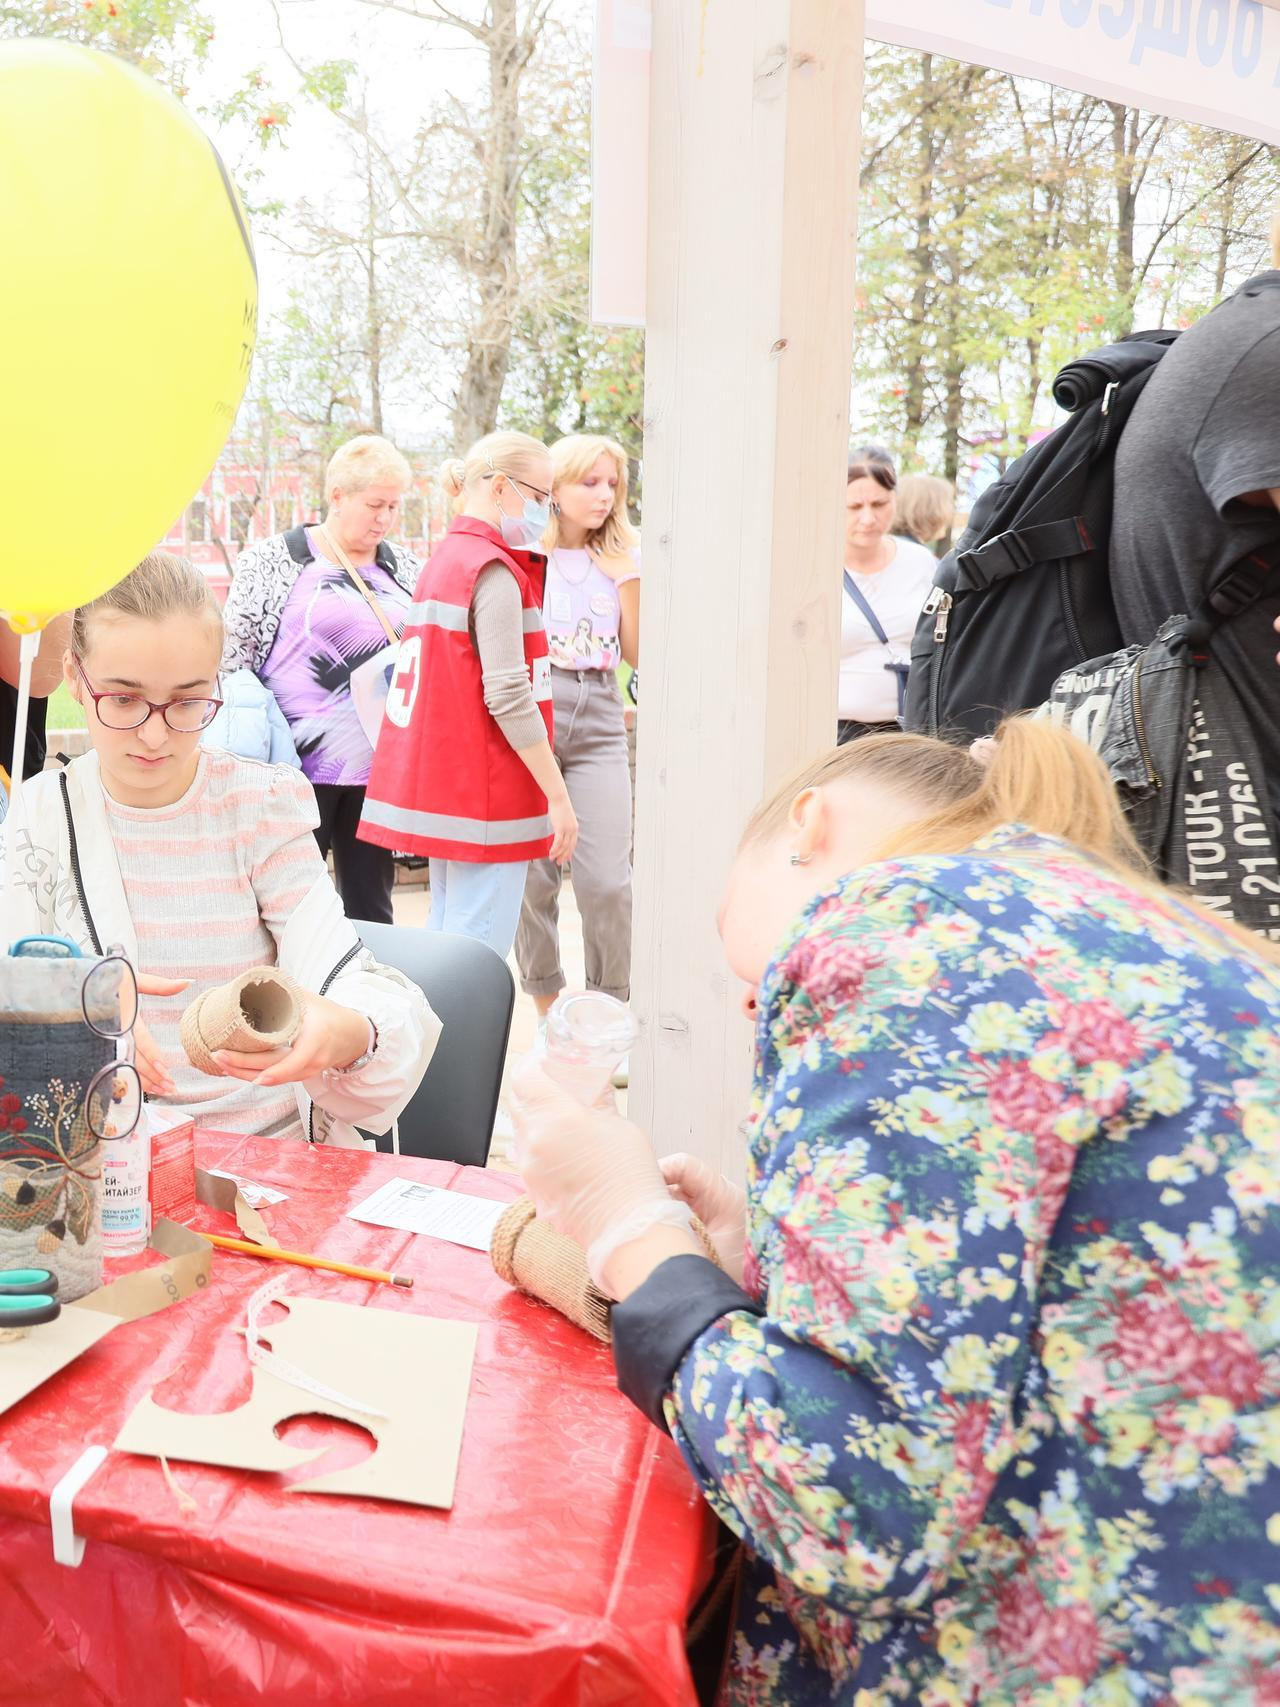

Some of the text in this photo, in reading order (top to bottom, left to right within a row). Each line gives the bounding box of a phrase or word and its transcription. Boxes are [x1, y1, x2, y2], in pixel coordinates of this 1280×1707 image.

[1183, 789, 1229, 886] TOUR
[104, 1176, 121, 1186] ЕЙ-
[103, 1185, 142, 1198] ИТАЙЗЕР
